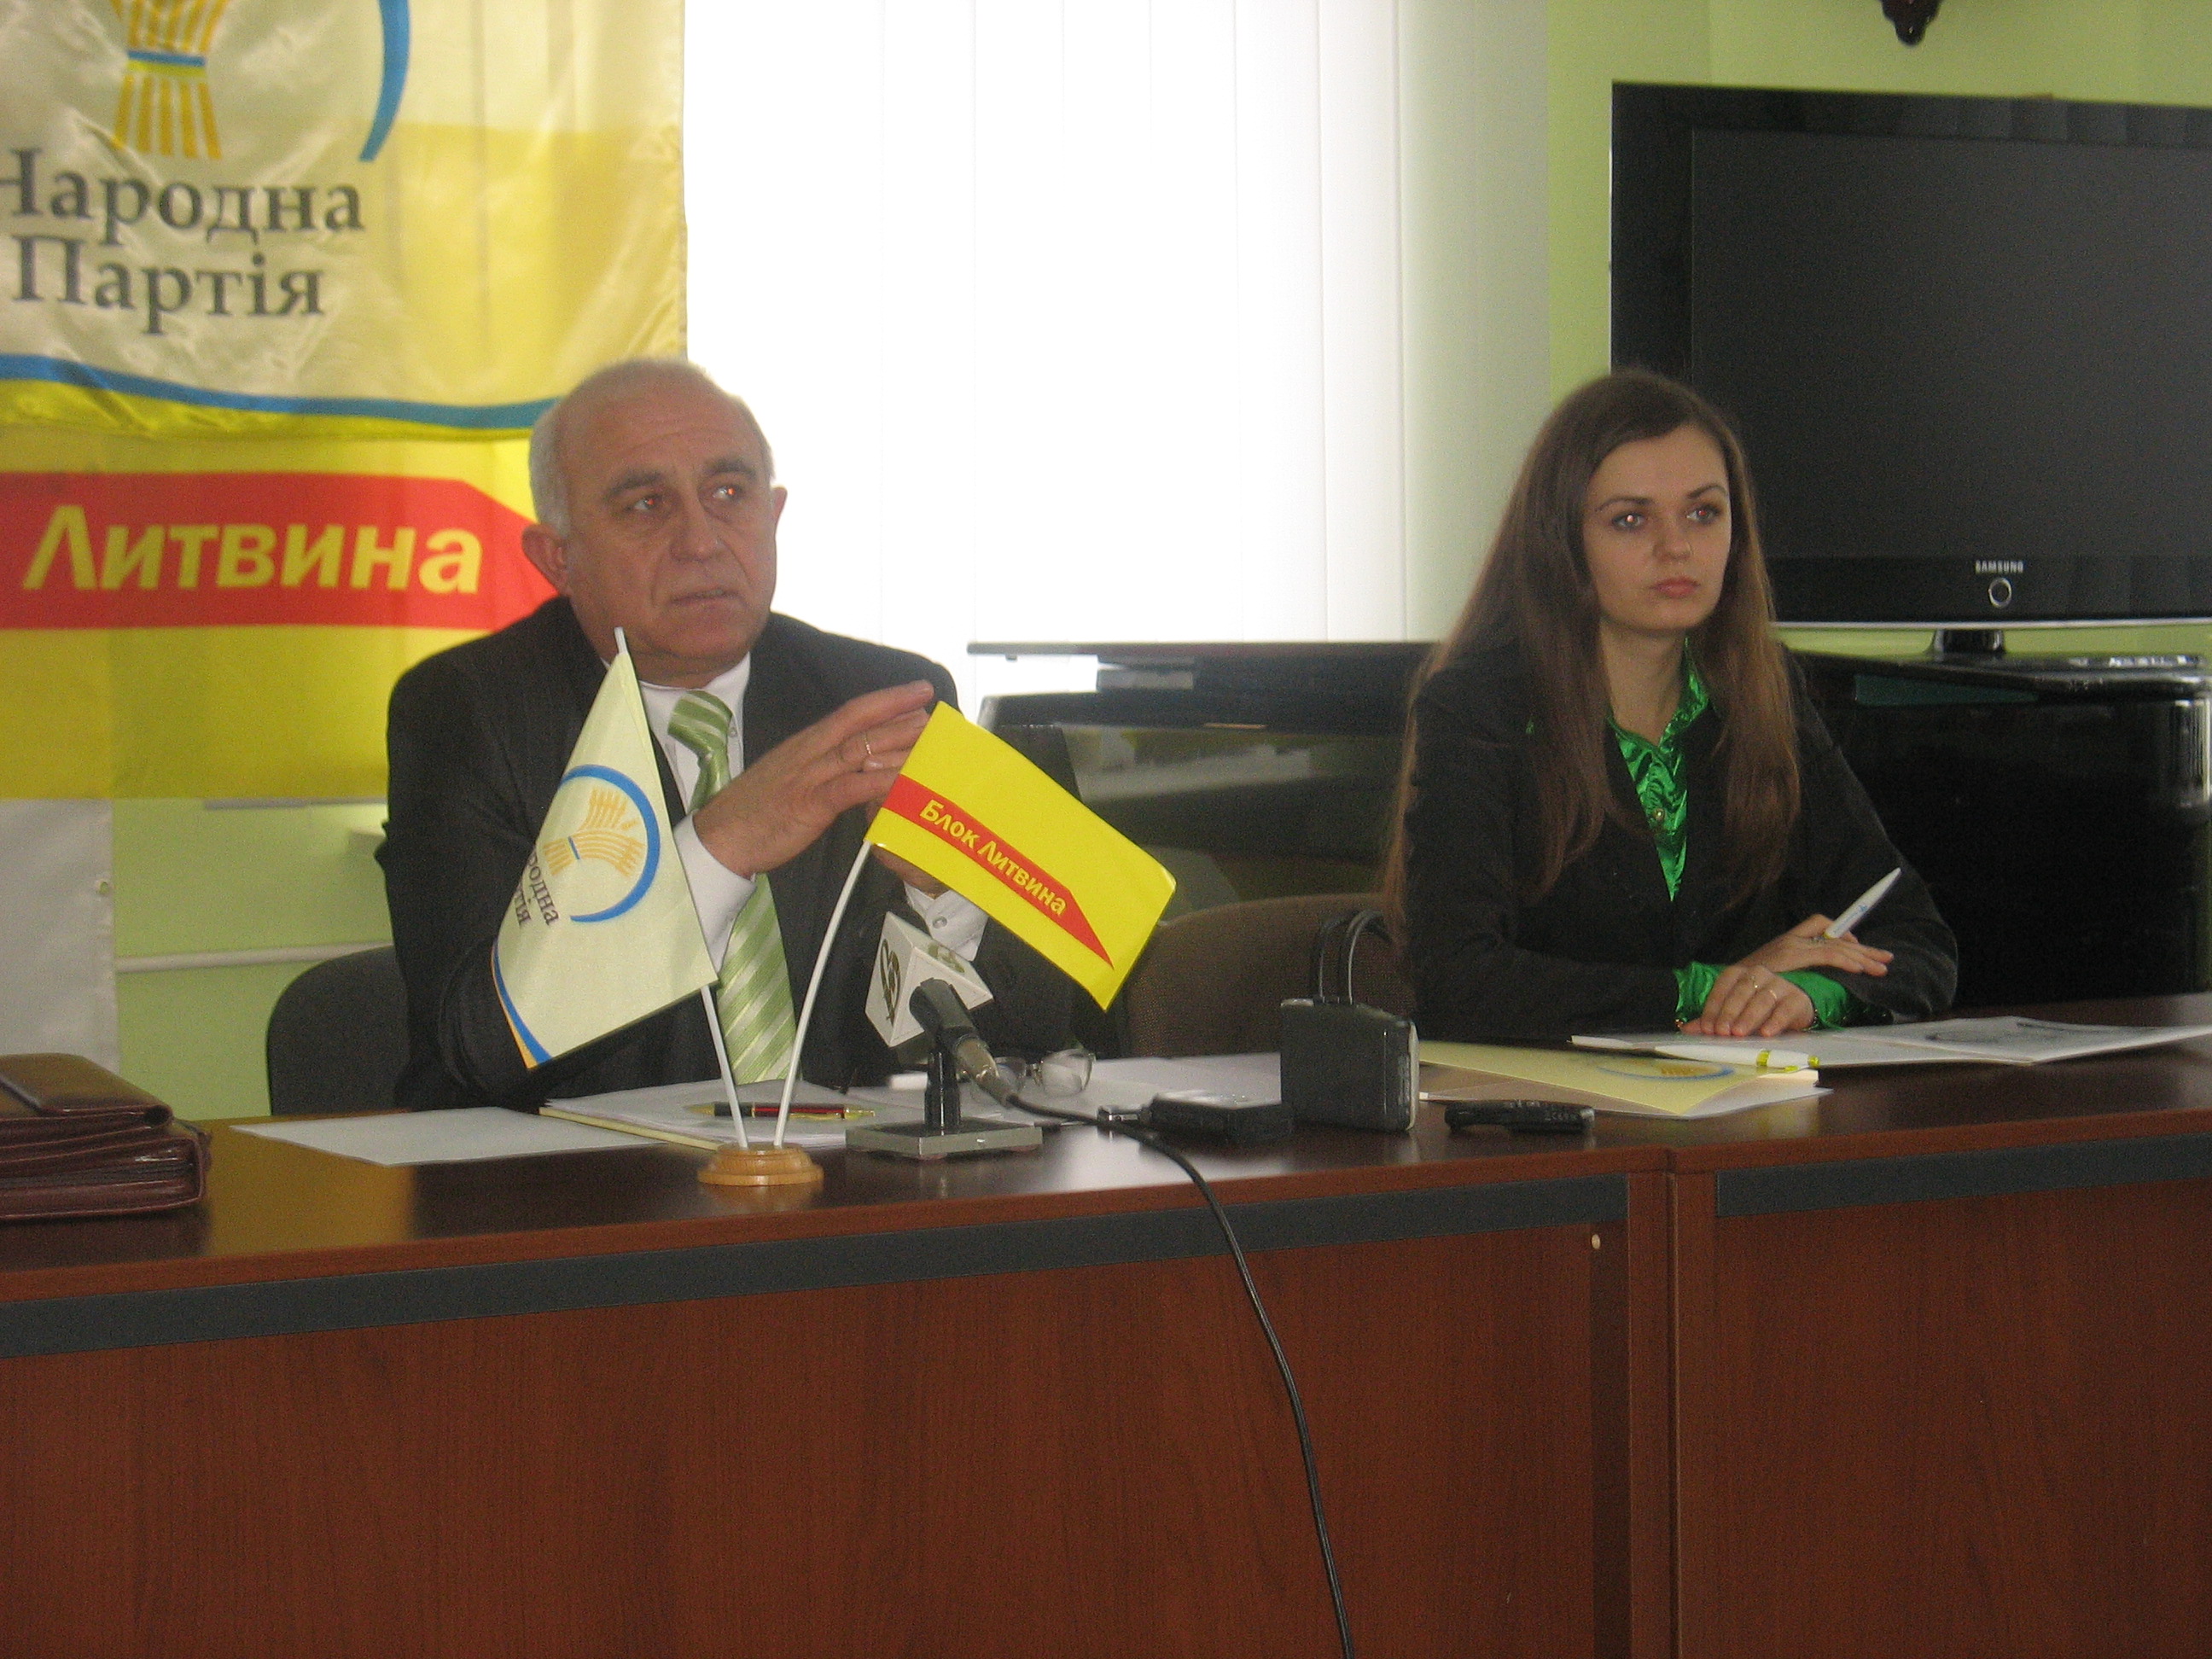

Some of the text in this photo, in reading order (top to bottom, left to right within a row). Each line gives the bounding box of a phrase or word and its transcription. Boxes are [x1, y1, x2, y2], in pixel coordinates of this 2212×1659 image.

[12, 234, 325, 335] Партія
[22, 505, 484, 595] Литвина
[919, 799, 1067, 915] Блок Литвина
